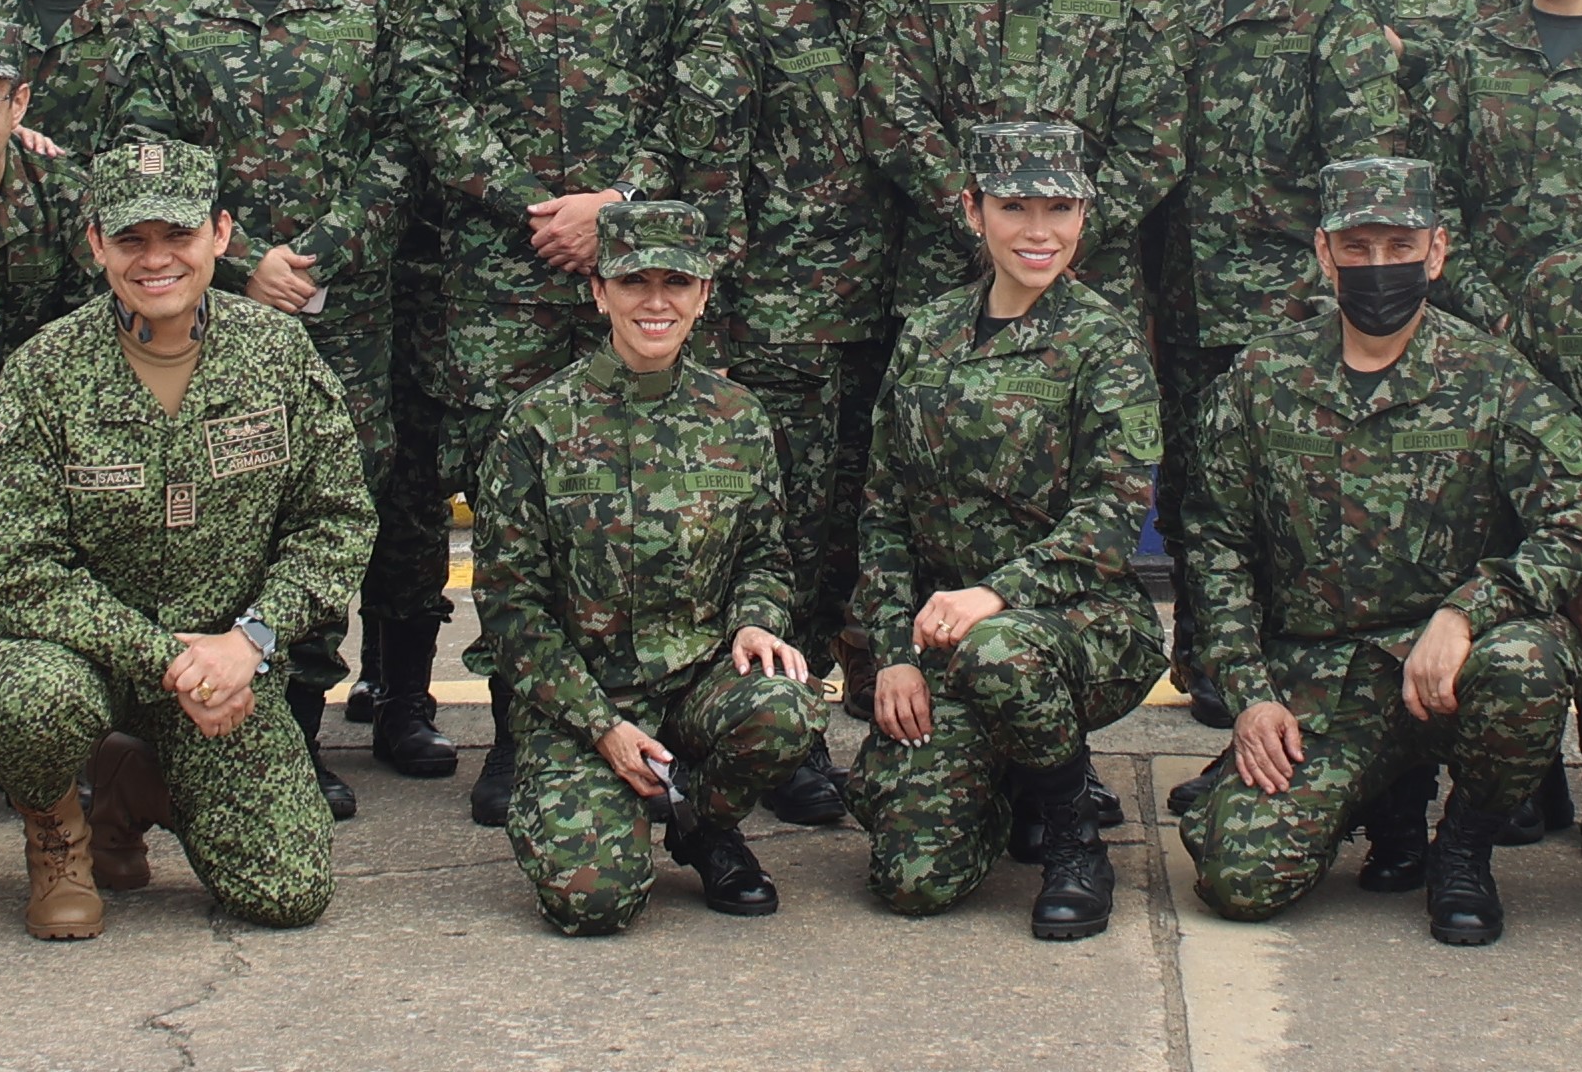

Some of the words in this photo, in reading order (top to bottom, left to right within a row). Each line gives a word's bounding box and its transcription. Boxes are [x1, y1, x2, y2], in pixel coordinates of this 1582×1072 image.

[186, 34, 230, 50] MENDEZ
[316, 27, 364, 42] EJERCITO
[788, 51, 832, 71] OROZCO
[1006, 377, 1061, 399] EJERCITO
[1401, 433, 1460, 448] EJERCITO
[228, 449, 281, 471] ARMADA
[695, 474, 745, 490] EJERCITO
